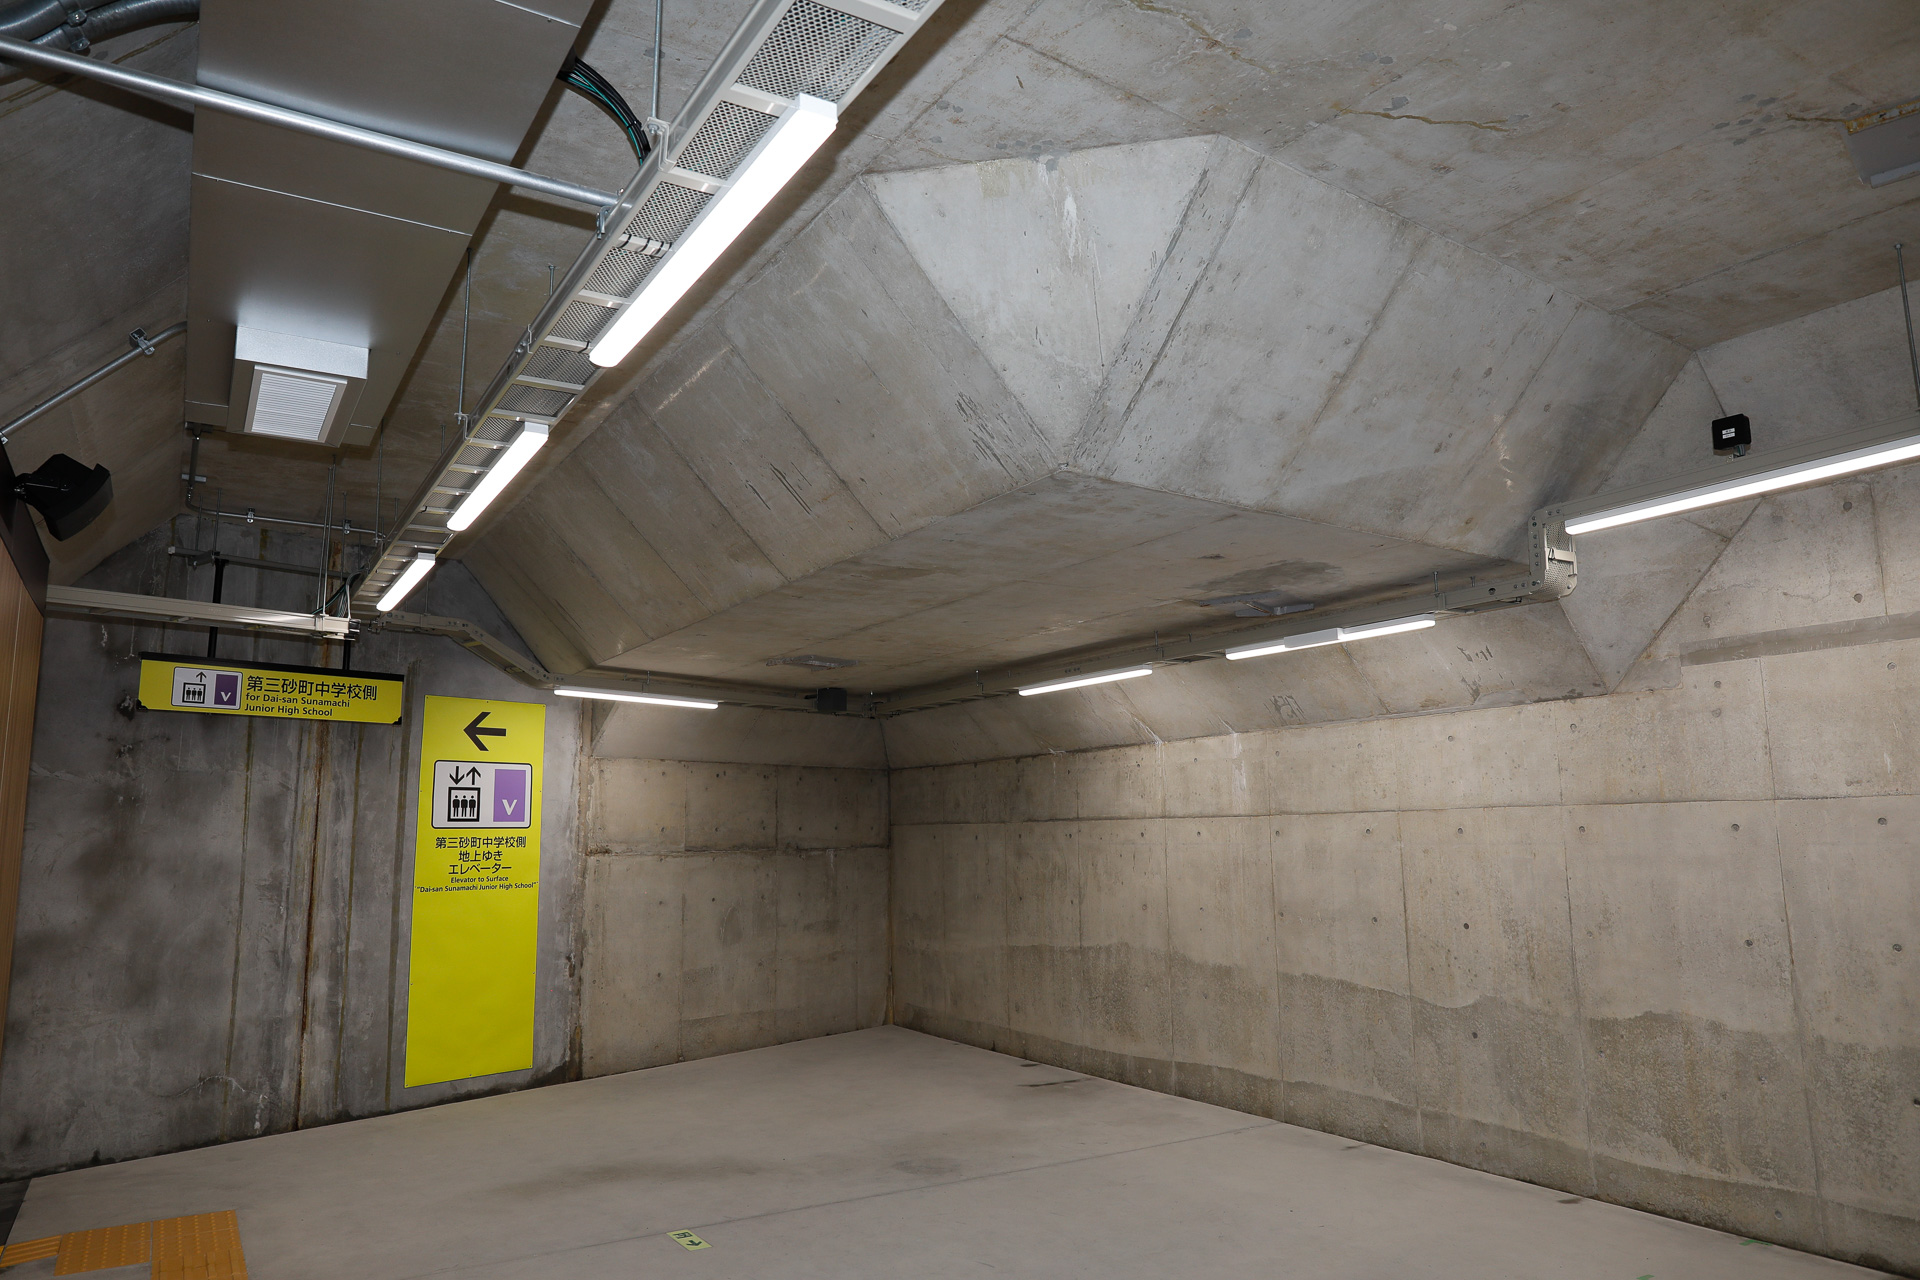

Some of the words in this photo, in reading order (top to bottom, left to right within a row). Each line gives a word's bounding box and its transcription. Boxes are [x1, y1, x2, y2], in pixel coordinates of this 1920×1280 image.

[247, 675, 377, 701] 第三砂町中学校側
[245, 693, 260, 702] for
[263, 694, 298, 704] Dai-san
[300, 697, 350, 708] Sunamachi
[244, 704, 275, 713] Junior
[278, 705, 300, 717] High
[302, 707, 333, 717] School
[435, 836, 527, 849] 第三砂町中学校側
[458, 850, 503, 862] 地上ゆき
[448, 863, 512, 875] エレベーター
[445, 884, 478, 892] Sunamachi
[499, 882, 513, 890] High
